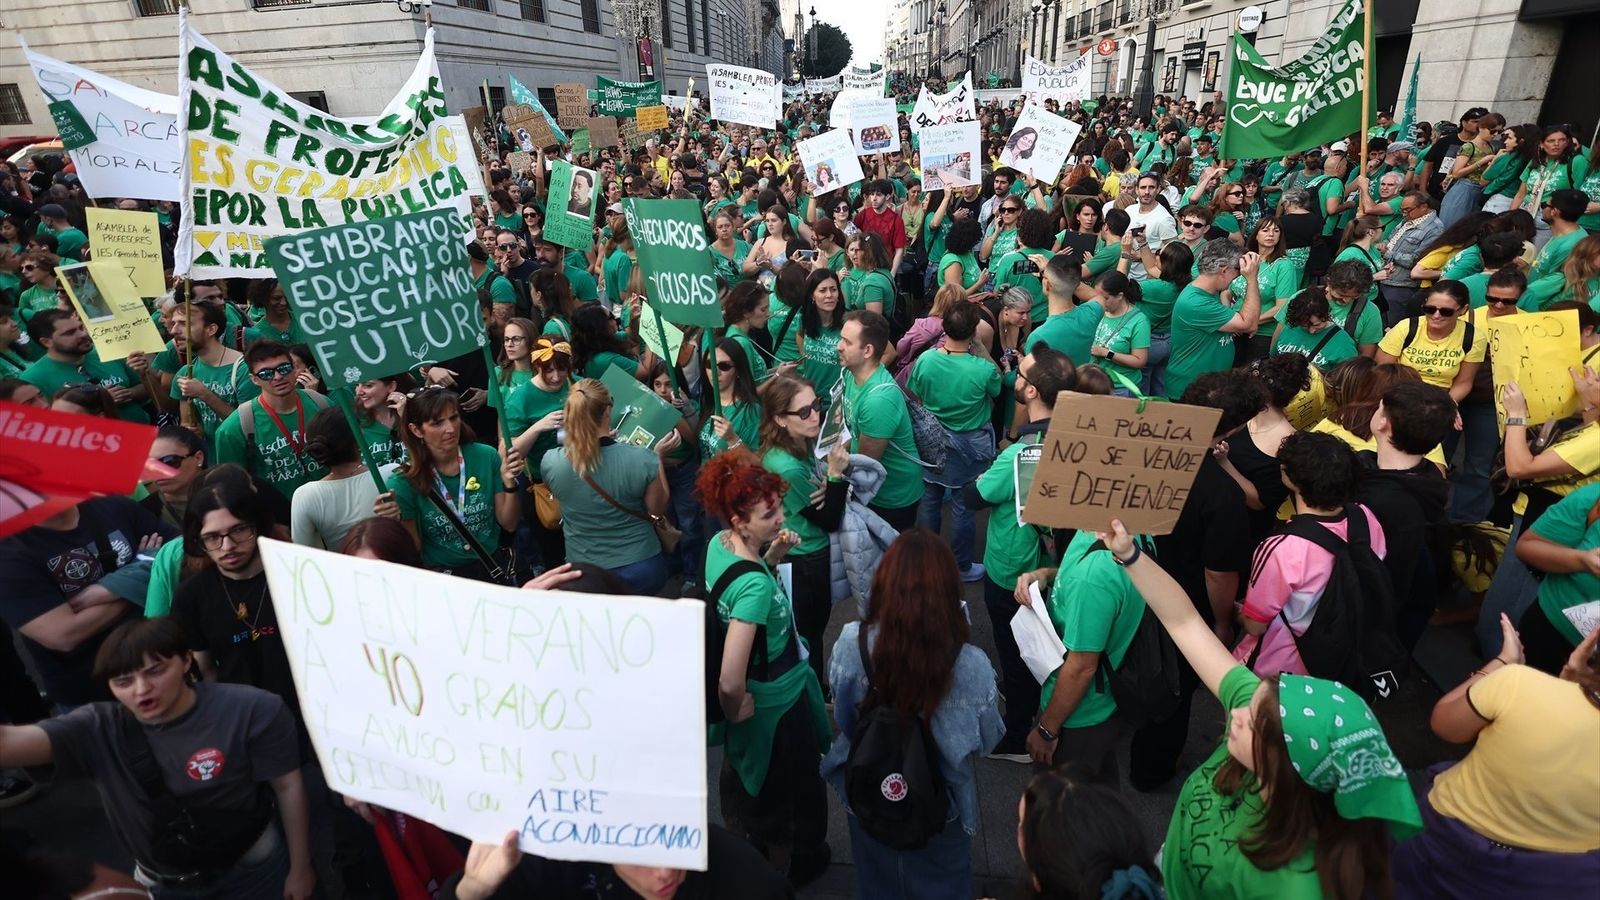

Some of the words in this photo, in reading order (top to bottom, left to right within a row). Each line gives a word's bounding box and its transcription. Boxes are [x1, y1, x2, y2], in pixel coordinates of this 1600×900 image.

[710, 67, 753, 84] ASAMBLEA
[714, 79, 727, 88] IES
[1038, 74, 1079, 89] PÚBLICA
[554, 166, 566, 175] MI
[276, 195, 328, 229] LA
[340, 163, 469, 226] PÚBLICA
[95, 222, 138, 233] ASAMBLEA
[101, 234, 153, 246] PROFESORES
[96, 248, 113, 259] IES
[278, 211, 468, 275] SEMBRAMOS
[290, 240, 470, 310] EDUCACIÓN
[1408, 356, 1458, 368] ESPECIAL
[1075, 414, 1097, 432] LA
[1114, 415, 1193, 441] PÚBLICA
[1050, 439, 1088, 464] NO
[1100, 445, 1128, 467] SE
[1143, 445, 1202, 472] VENDE
[1039, 481, 1059, 499] SE
[1069, 470, 1190, 511] DEFIENDE
[278, 554, 335, 626] YO
[352, 571, 420, 647] EN
[446, 597, 655, 674] VERANO
[303, 627, 339, 693] A
[361, 642, 425, 717] 40
[445, 671, 595, 731] GRADOS
[360, 712, 456, 766] AYUSO
[478, 742, 524, 784] EN
[549, 748, 598, 784] SU
[330, 745, 447, 813] OFICINA
[527, 787, 609, 814] AIRE
